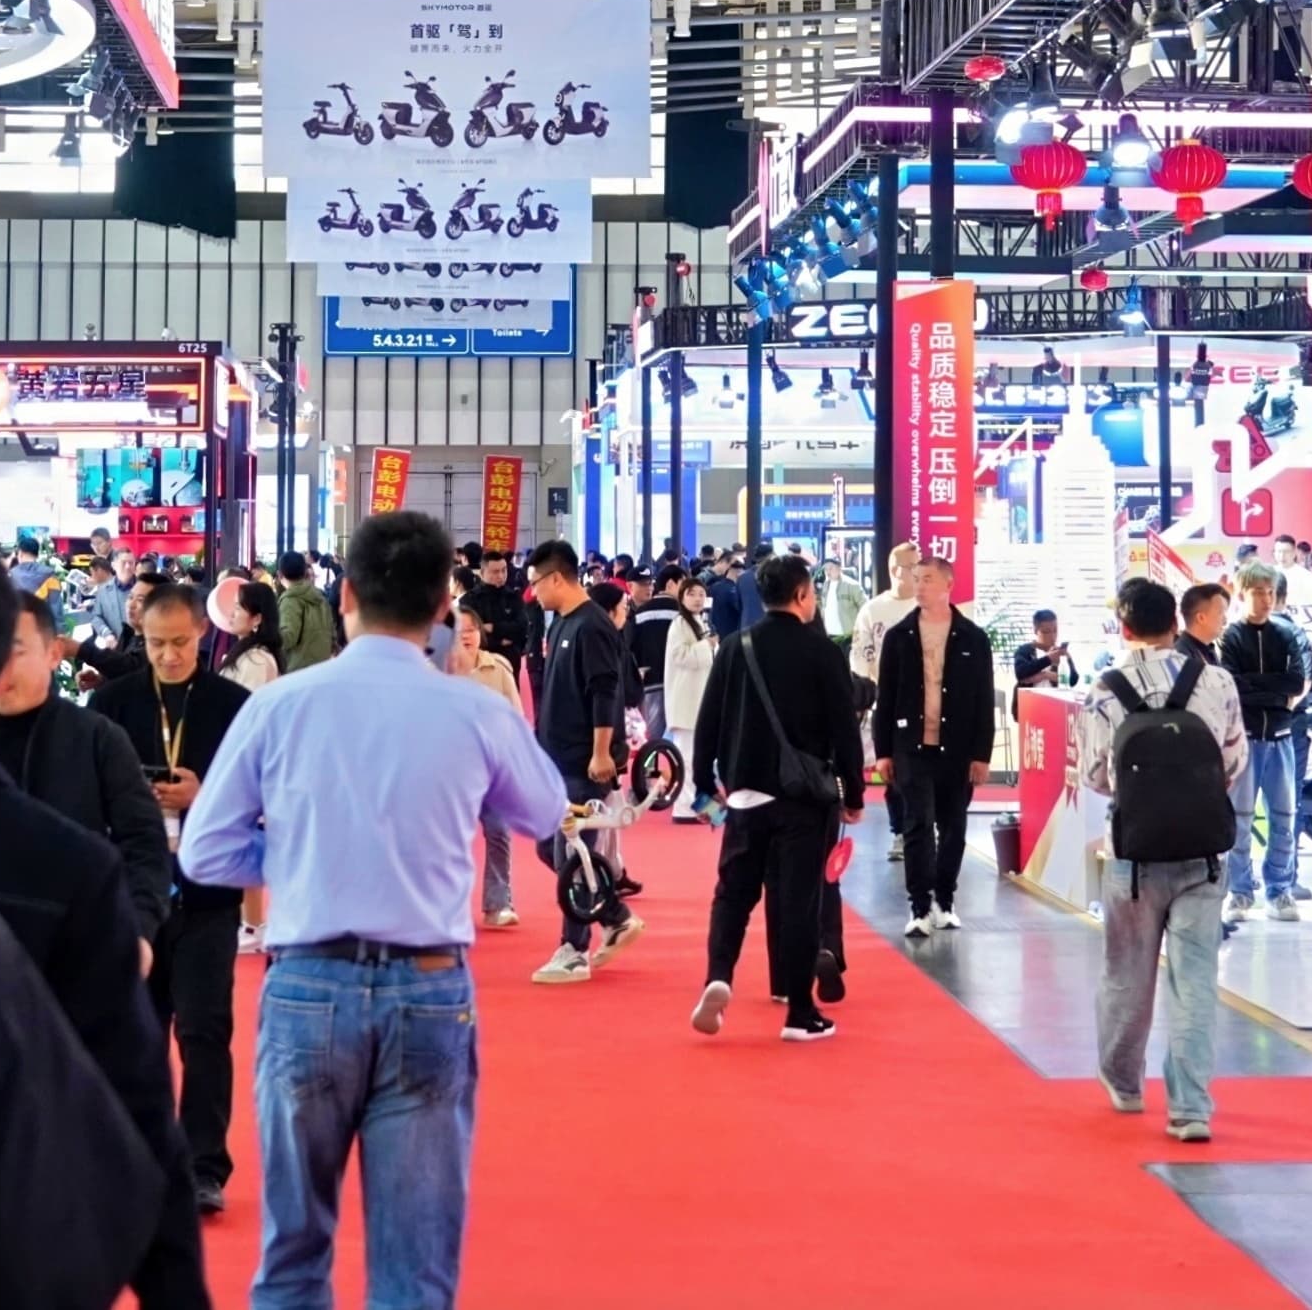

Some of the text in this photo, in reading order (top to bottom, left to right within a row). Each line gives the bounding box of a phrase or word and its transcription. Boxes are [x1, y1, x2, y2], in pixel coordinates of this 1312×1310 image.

[178, 343, 207, 353] 6T25
[909, 323, 921, 369] Quality
[16, 369, 146, 401] 黄岩五星
[909, 374, 922, 425] stability
[911, 430, 923, 507] overwhelms
